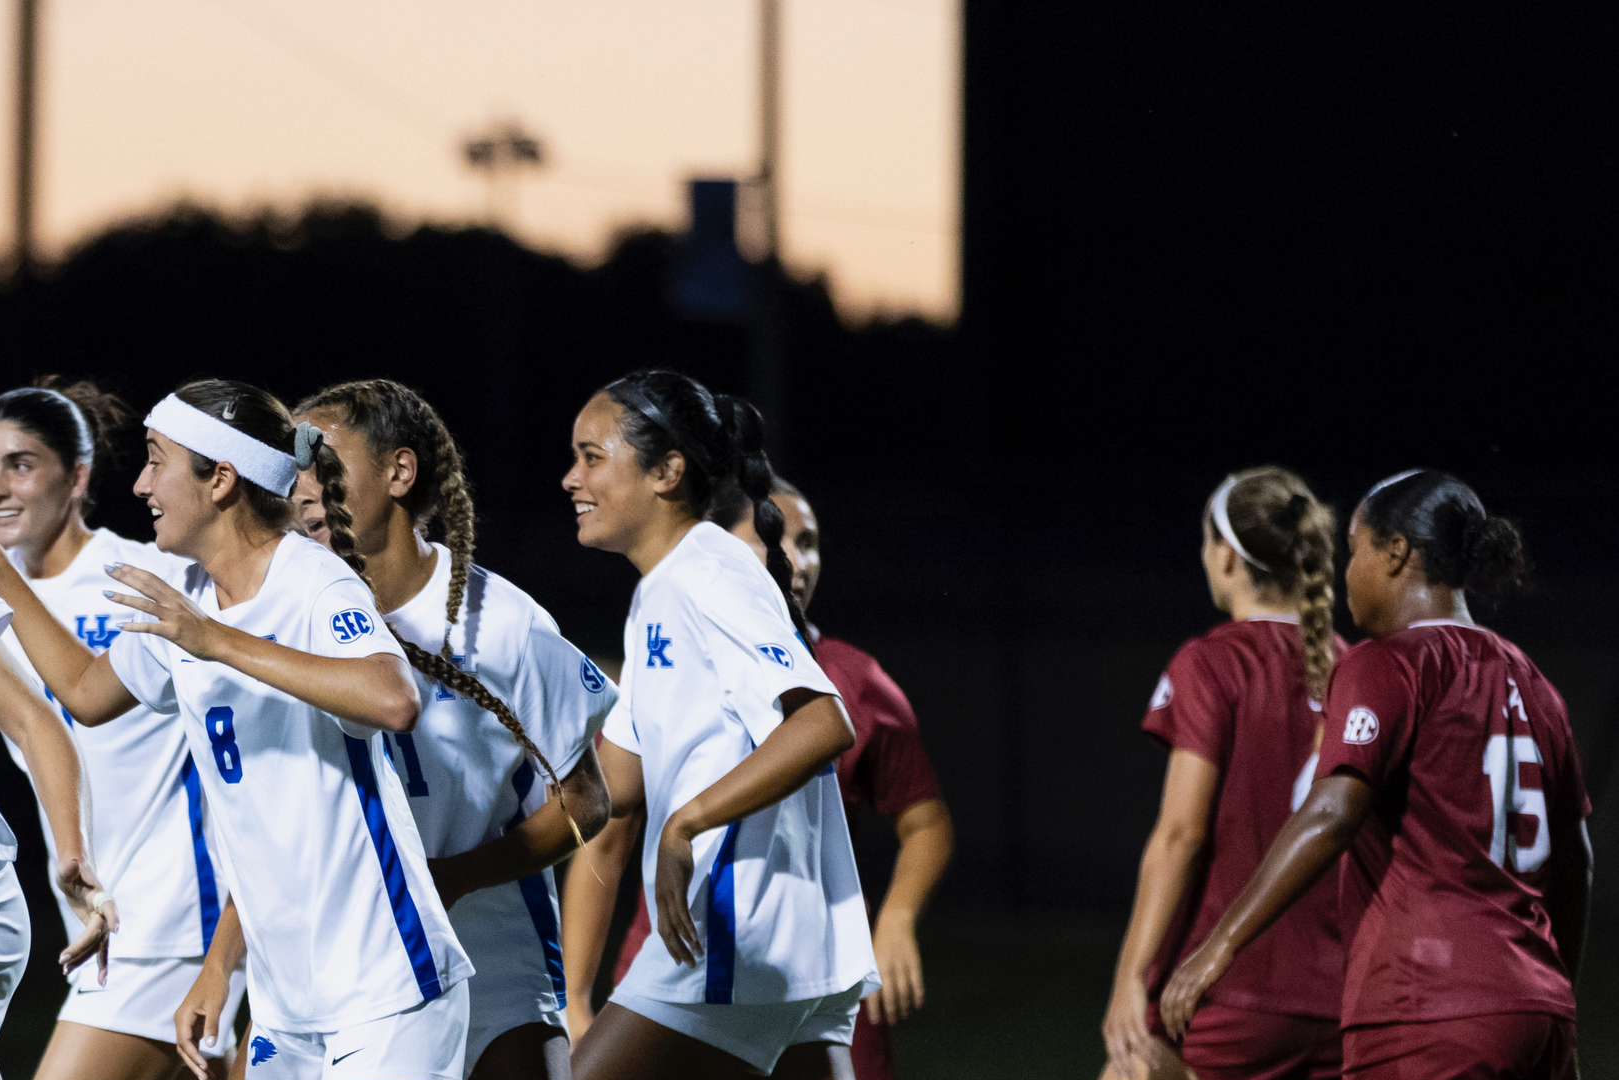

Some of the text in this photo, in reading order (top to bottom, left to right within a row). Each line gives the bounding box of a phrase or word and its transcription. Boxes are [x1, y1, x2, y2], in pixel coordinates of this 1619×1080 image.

[332, 610, 371, 641] SEC
[646, 623, 674, 668] UK
[206, 706, 243, 784] 8
[1483, 735, 1551, 872] 15
